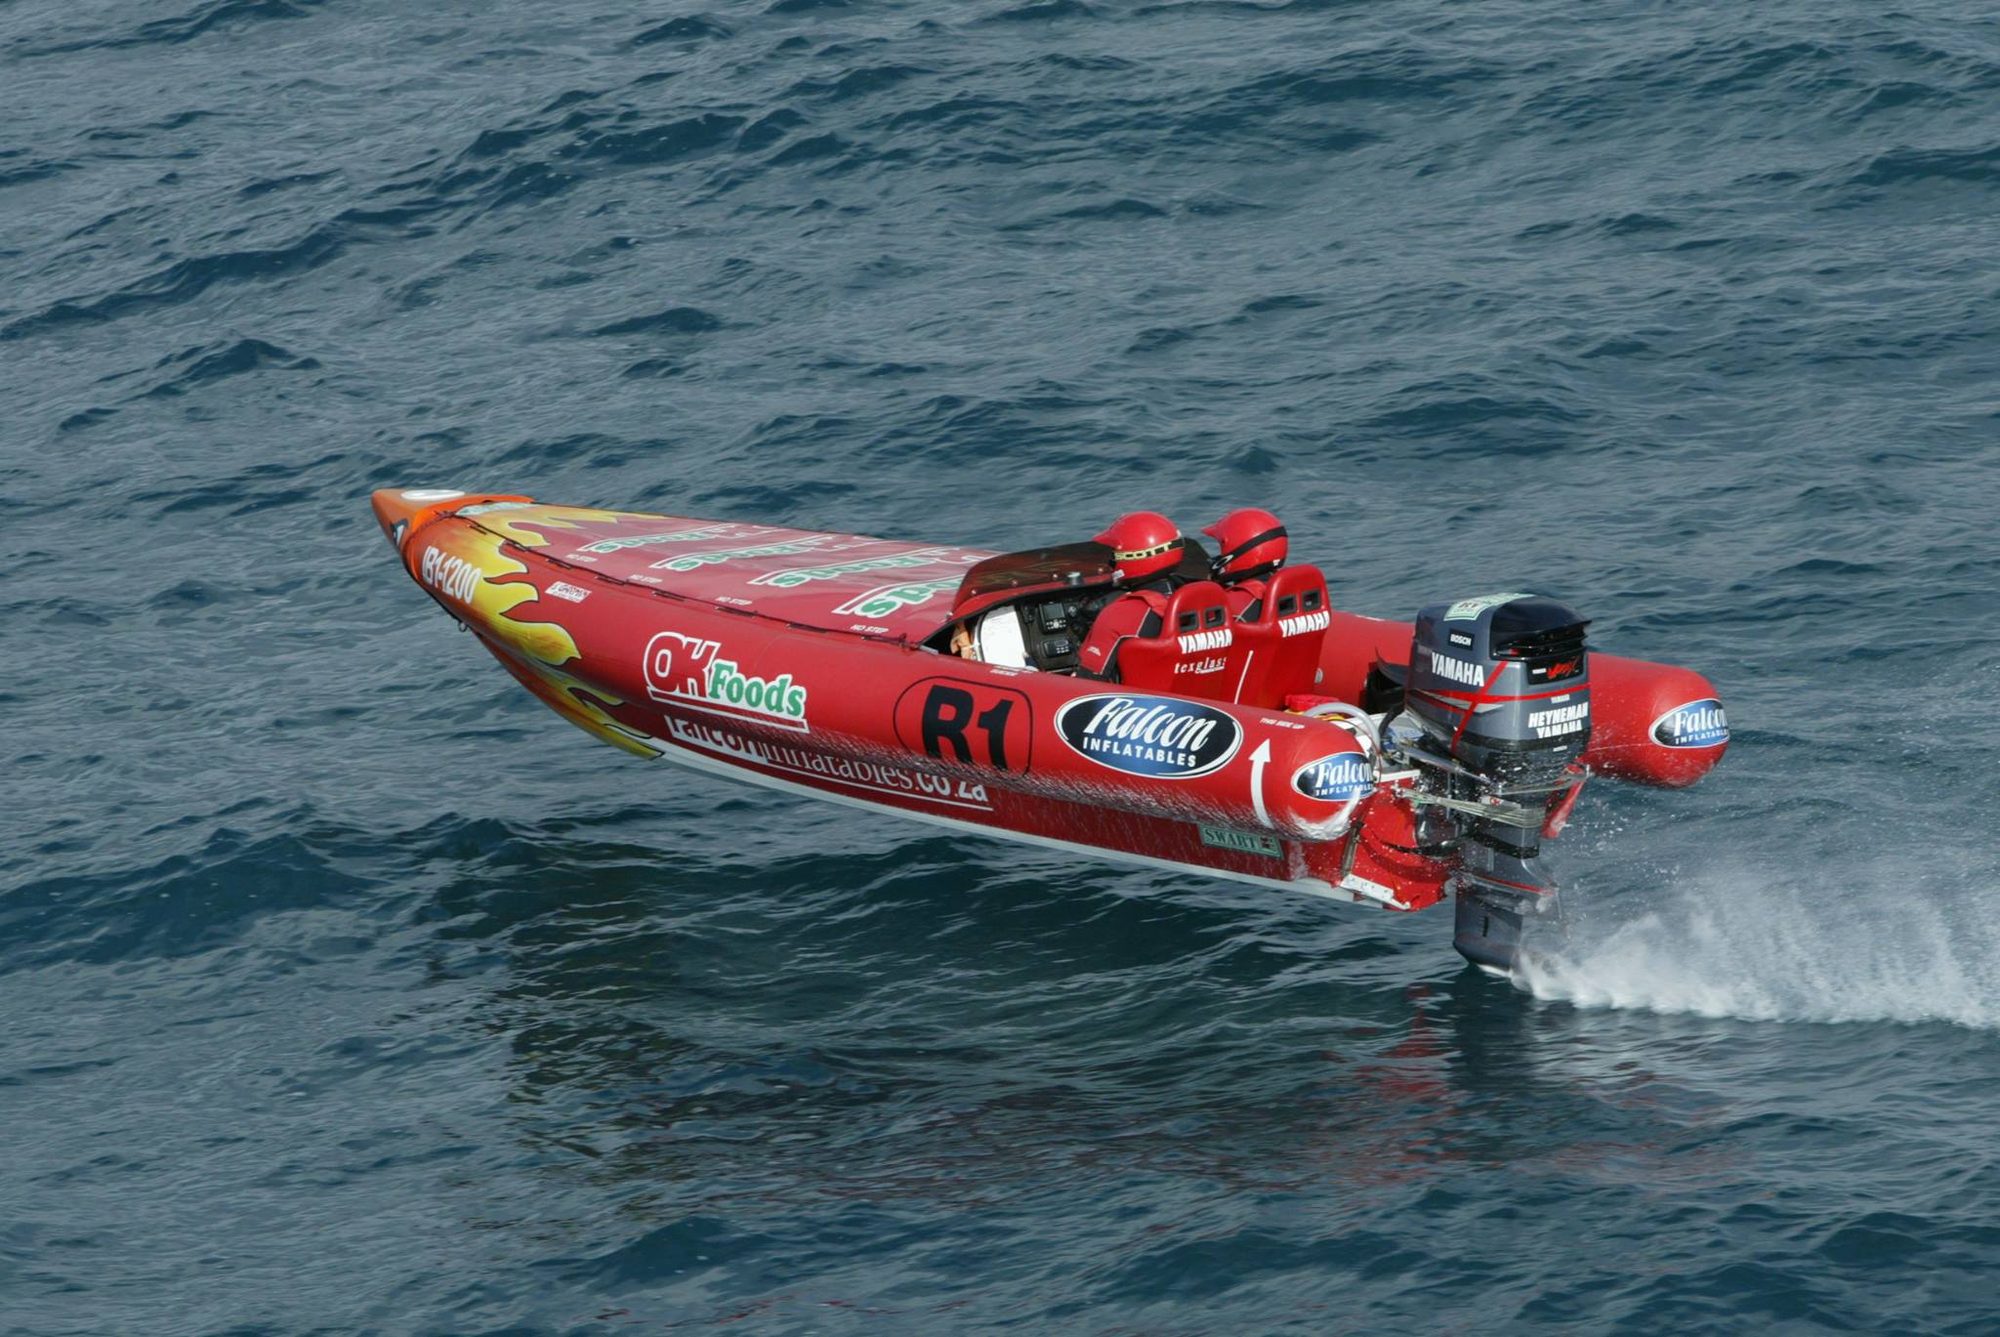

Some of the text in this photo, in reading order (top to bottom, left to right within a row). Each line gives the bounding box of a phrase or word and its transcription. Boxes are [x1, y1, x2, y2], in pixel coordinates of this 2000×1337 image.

[1114, 541, 1173, 561] SCOTT
[1278, 611, 1331, 638] YAMAHA
[1177, 628, 1233, 654] YAMAHA
[1450, 633, 1472, 647] BOSCH
[1431, 652, 1485, 687] YAMAHA
[708, 659, 807, 718] Foods
[922, 685, 1014, 772] R1
[1083, 697, 1218, 753] Falcon
[1528, 702, 1589, 729] HEYNEMAN
[1536, 719, 1583, 739] YAMAHA
[1082, 736, 1197, 768] INFLATABLES
